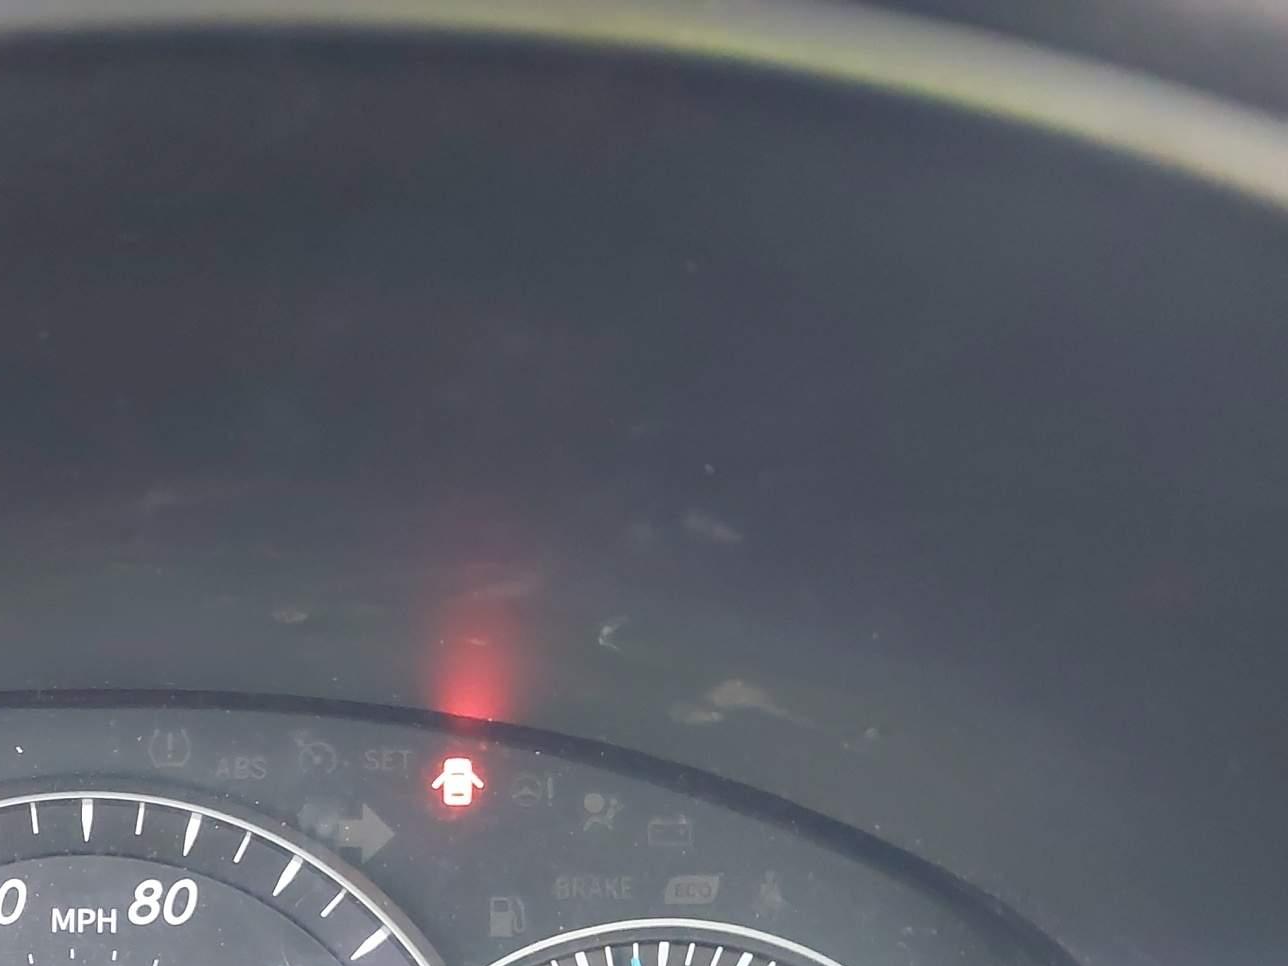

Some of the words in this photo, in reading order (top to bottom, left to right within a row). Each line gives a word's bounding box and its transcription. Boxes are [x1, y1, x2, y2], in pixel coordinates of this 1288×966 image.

[215, 756, 267, 780] ABS
[363, 749, 413, 771] SET
[555, 876, 633, 900] BRAKE
[127, 878, 198, 926] 80
[51, 907, 117, 934] MPH
